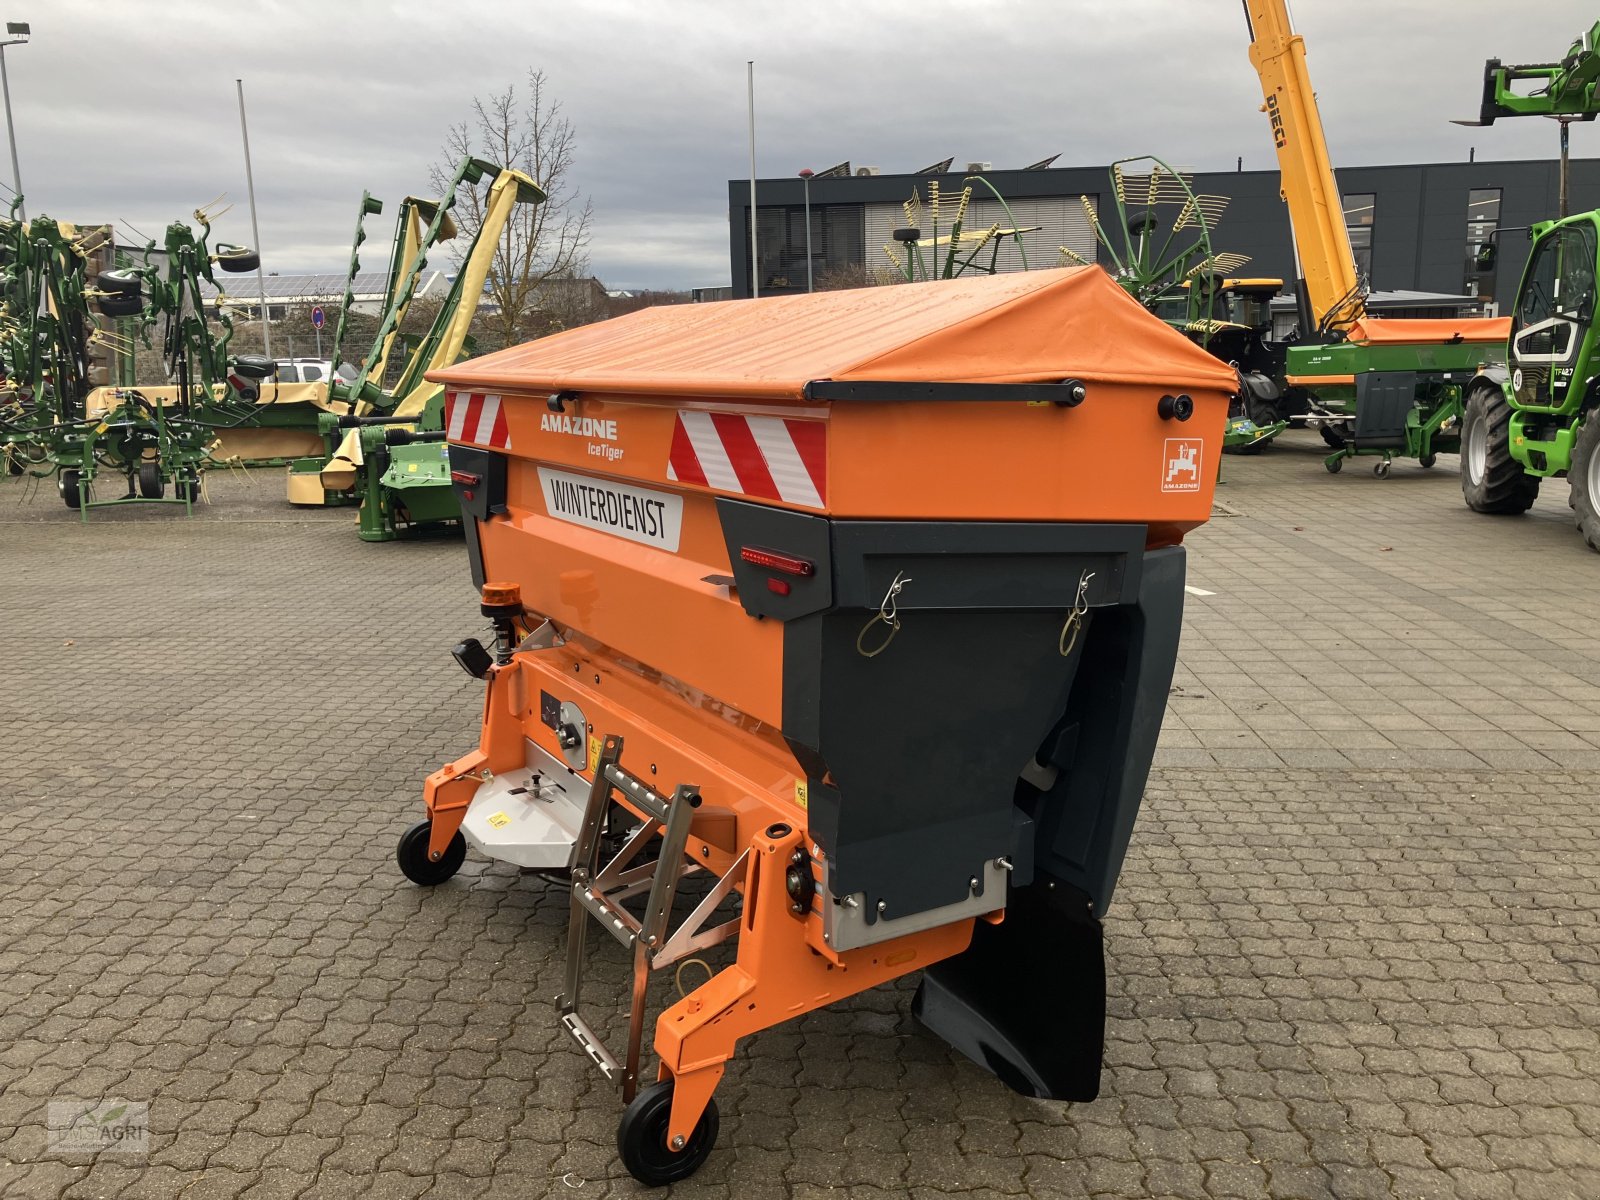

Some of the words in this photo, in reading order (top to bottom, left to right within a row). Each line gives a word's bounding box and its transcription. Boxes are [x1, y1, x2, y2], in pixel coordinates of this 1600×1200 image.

[1266, 93, 1287, 149] DIECI
[540, 413, 618, 441] AMAZONE
[587, 441, 624, 461] IceTiger
[550, 478, 665, 539] WINTERDIENST
